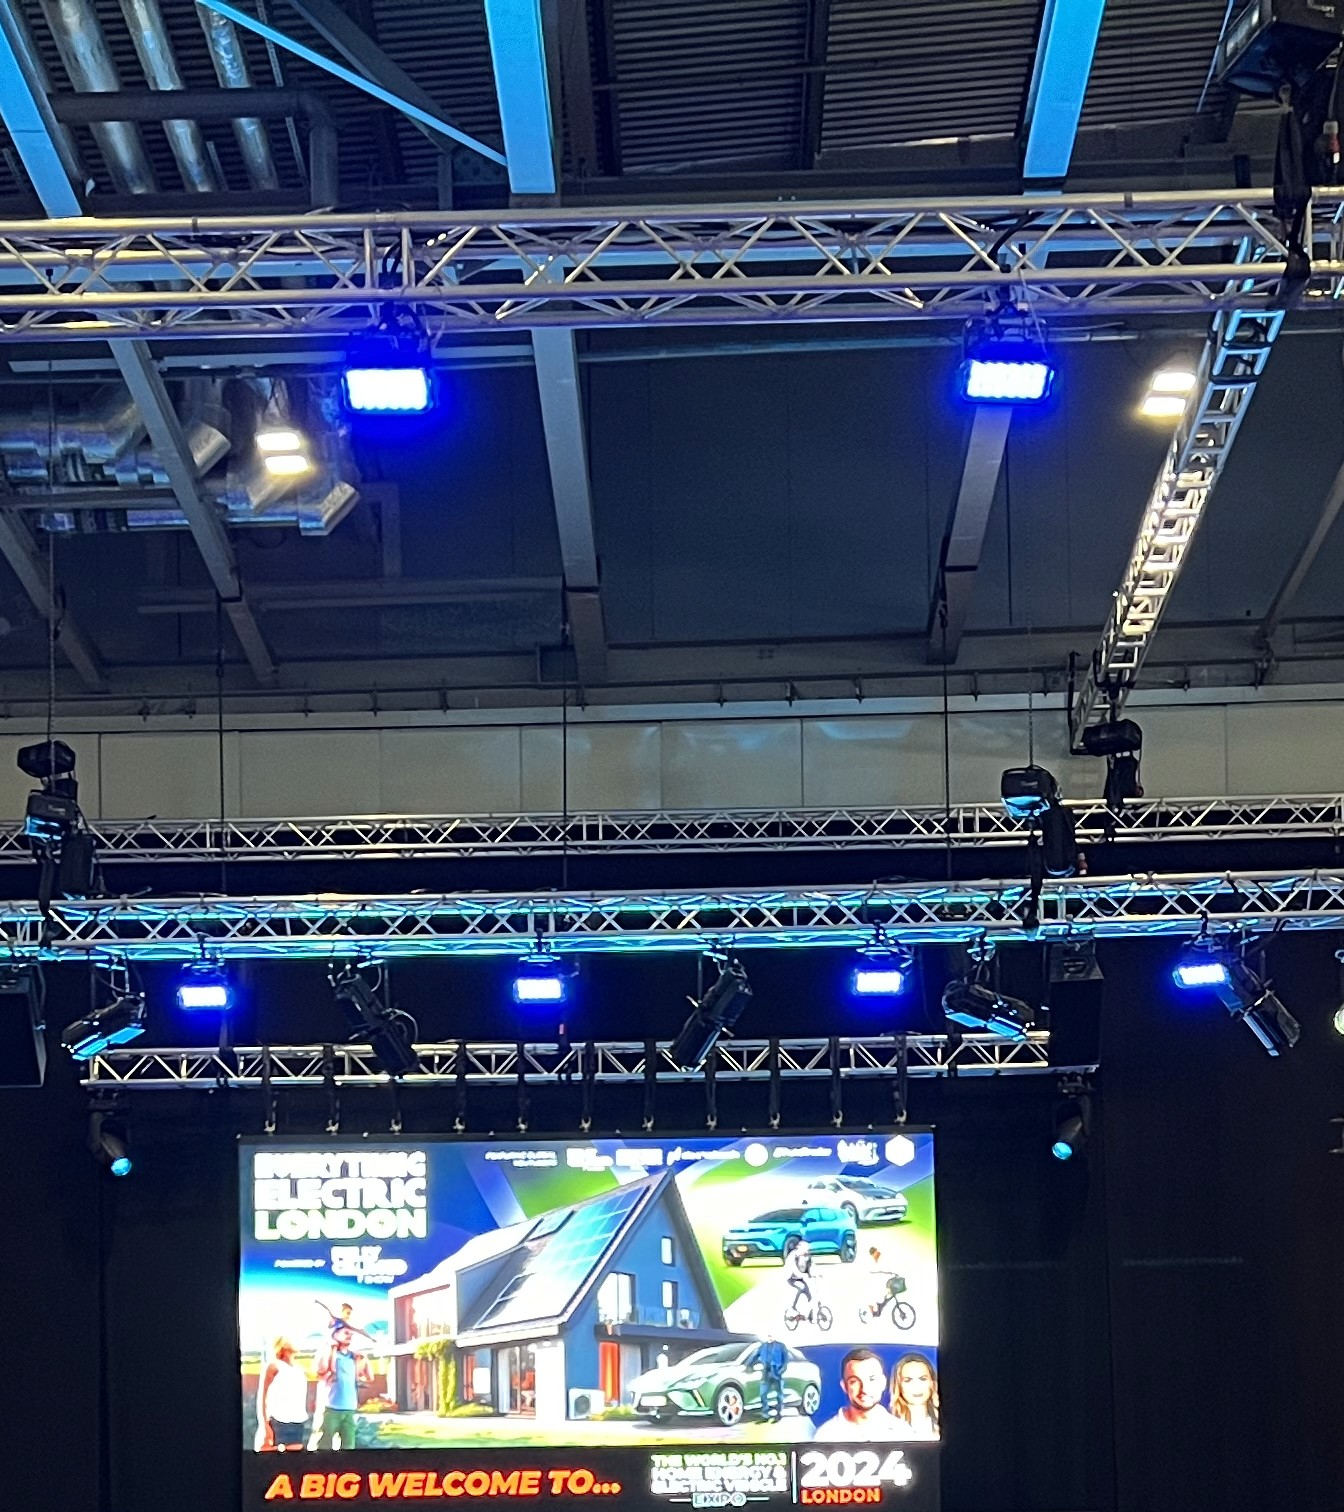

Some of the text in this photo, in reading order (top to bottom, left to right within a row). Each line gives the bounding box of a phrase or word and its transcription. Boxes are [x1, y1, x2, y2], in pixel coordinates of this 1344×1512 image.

[254, 1177, 427, 1209] ELECTRIC
[254, 1208, 427, 1240] LONDON
[264, 1468, 622, 1499] A BIG WELCOME TO...
[799, 1450, 913, 1488] 2024
[692, 1492, 747, 1508] EXPO
[801, 1487, 881, 1504] LONDON
